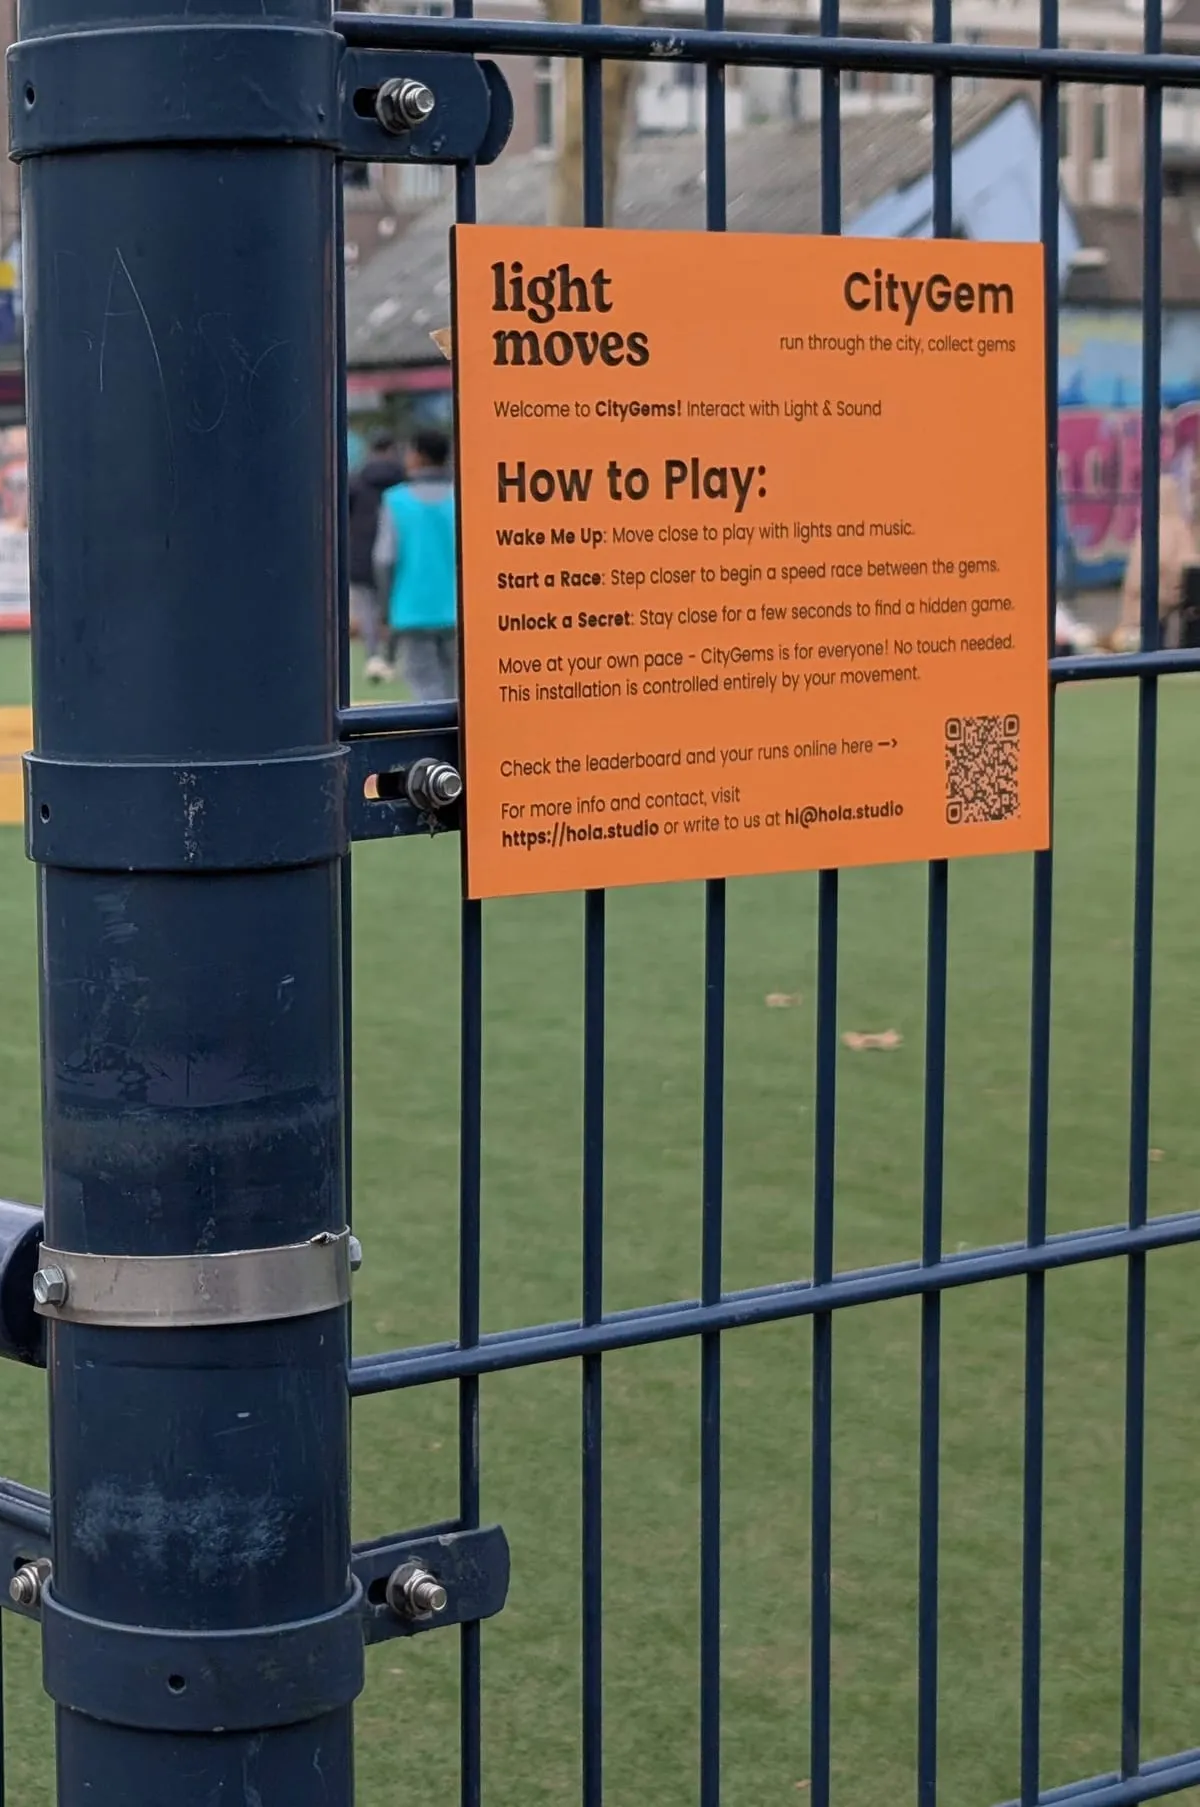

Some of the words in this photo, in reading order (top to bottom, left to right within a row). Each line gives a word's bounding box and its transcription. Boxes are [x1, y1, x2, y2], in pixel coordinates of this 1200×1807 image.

[491, 262, 612, 323] light
[844, 269, 1012, 325] CityGem
[492, 331, 649, 366] moves
[779, 336, 804, 351] run
[807, 333, 865, 357] through
[869, 334, 893, 352] the
[895, 334, 924, 356] city,
[927, 335, 974, 353] collect
[976, 339, 1016, 358] gems
[493, 399, 571, 418] Welcome
[574, 401, 591, 418] to
[594, 398, 682, 423] CityGems!
[687, 400, 746, 417] Interact
[748, 399, 780, 417] with
[784, 399, 819, 422] Light
[822, 399, 833, 417] &
[836, 399, 882, 417] Sound
[498, 462, 592, 502] How
[607, 462, 648, 500] to
[665, 458, 765, 512] Play:
[495, 527, 546, 547] Wake
[550, 527, 576, 545] Me
[580, 527, 607, 550] Up:
[612, 527, 655, 544] Move
[658, 525, 699, 543] close
[702, 525, 718, 542] to
[722, 523, 755, 546] play
[758, 522, 789, 540] with
[793, 521, 833, 544] lights
[836, 520, 865, 538] and
[869, 518, 916, 537] music.
[497, 571, 540, 590] Start
[543, 574, 555, 588] a
[560, 569, 606, 588] Race:
[610, 568, 646, 590] Step
[649, 567, 697, 585] closer
[700, 566, 717, 583] to
[719, 564, 762, 587] begin
[766, 567, 777, 581] a
[780, 561, 826, 585] speed
[830, 563, 864, 578] race
[867, 560, 928, 577] between
[931, 558, 956, 575] the
[958, 559, 1000, 579] gems.
[497, 612, 558, 632] Unlock
[561, 615, 573, 629] a
[577, 610, 635, 629] Secret:
[639, 609, 674, 630] Stay
[677, 607, 718, 625] close
[721, 605, 743, 623] for
[746, 608, 757, 622] a
[760, 603, 788, 621] few
[791, 600, 853, 620] seconds
[855, 601, 871, 617] to
[874, 598, 902, 616] find
[905, 601, 915, 616] a
[919, 596, 968, 614] hidden
[970, 598, 1015, 618] game.
[498, 657, 542, 675] Move
[546, 655, 564, 672] at
[567, 656, 603, 676] your
[606, 654, 639, 669] own
[643, 652, 684, 673] pace
[700, 646, 775, 669] CityGems
[778, 644, 791, 661] is
[793, 642, 814, 660] for
[817, 639, 889, 662] everyone!
[894, 639, 914, 655] No
[916, 636, 957, 654] touch
[960, 633, 1015, 652] needed.
[498, 684, 531, 703] This
[535, 679, 622, 701] installation
[625, 678, 639, 696] is
[642, 674, 719, 695] controlled
[723, 671, 778, 694] entirely
[781, 671, 801, 692] by
[803, 672, 837, 692] your
[840, 665, 921, 685] movement.
[500, 757, 552, 778] Check
[555, 756, 582, 774] the
[585, 748, 682, 772] leaderboard
[685, 746, 716, 765] and
[719, 747, 754, 768] your
[757, 744, 790, 761] runs
[793, 739, 838, 759] online
[841, 738, 874, 755] here
[501, 802, 526, 820] For
[530, 801, 573, 817] more
[576, 794, 606, 814] info
[610, 792, 641, 812] and
[644, 789, 707, 810] contact,
[711, 785, 741, 804] visit
[501, 818, 660, 852] https://hola.studio
[663, 821, 680, 836] or
[683, 815, 721, 833] write
[723, 814, 740, 831] to
[743, 814, 761, 829] us
[764, 810, 781, 828] at
[784, 799, 904, 830] hi@hola.studio
